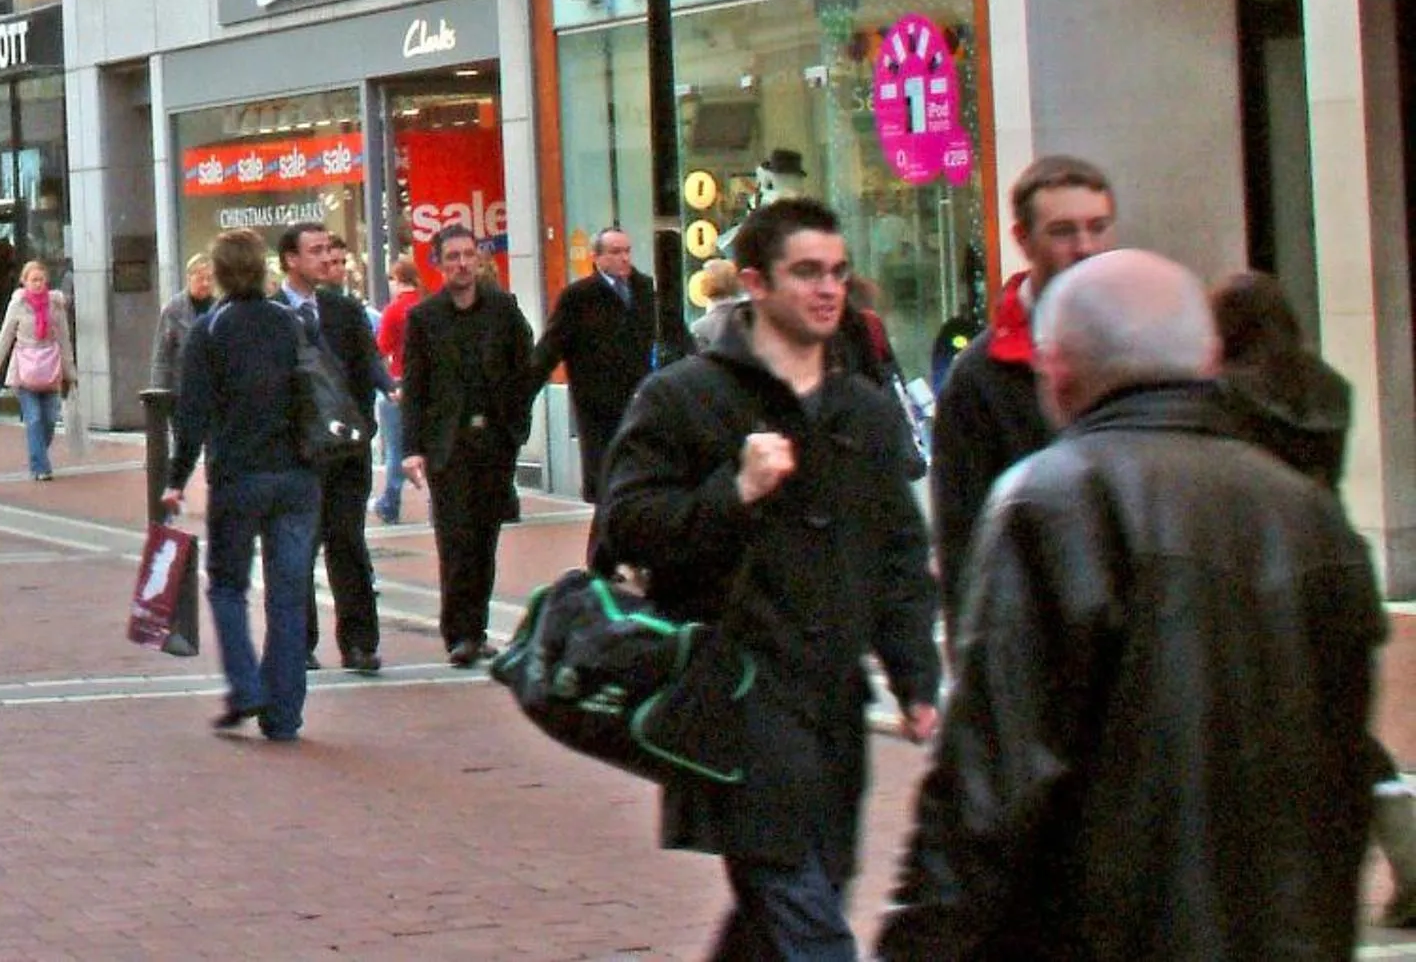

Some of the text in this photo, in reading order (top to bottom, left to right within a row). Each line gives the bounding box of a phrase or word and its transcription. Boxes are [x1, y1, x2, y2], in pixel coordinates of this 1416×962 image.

[402, 18, 456, 59] Clarks
[198, 140, 352, 185] sale sale sale sale
[412, 189, 508, 242] sale
